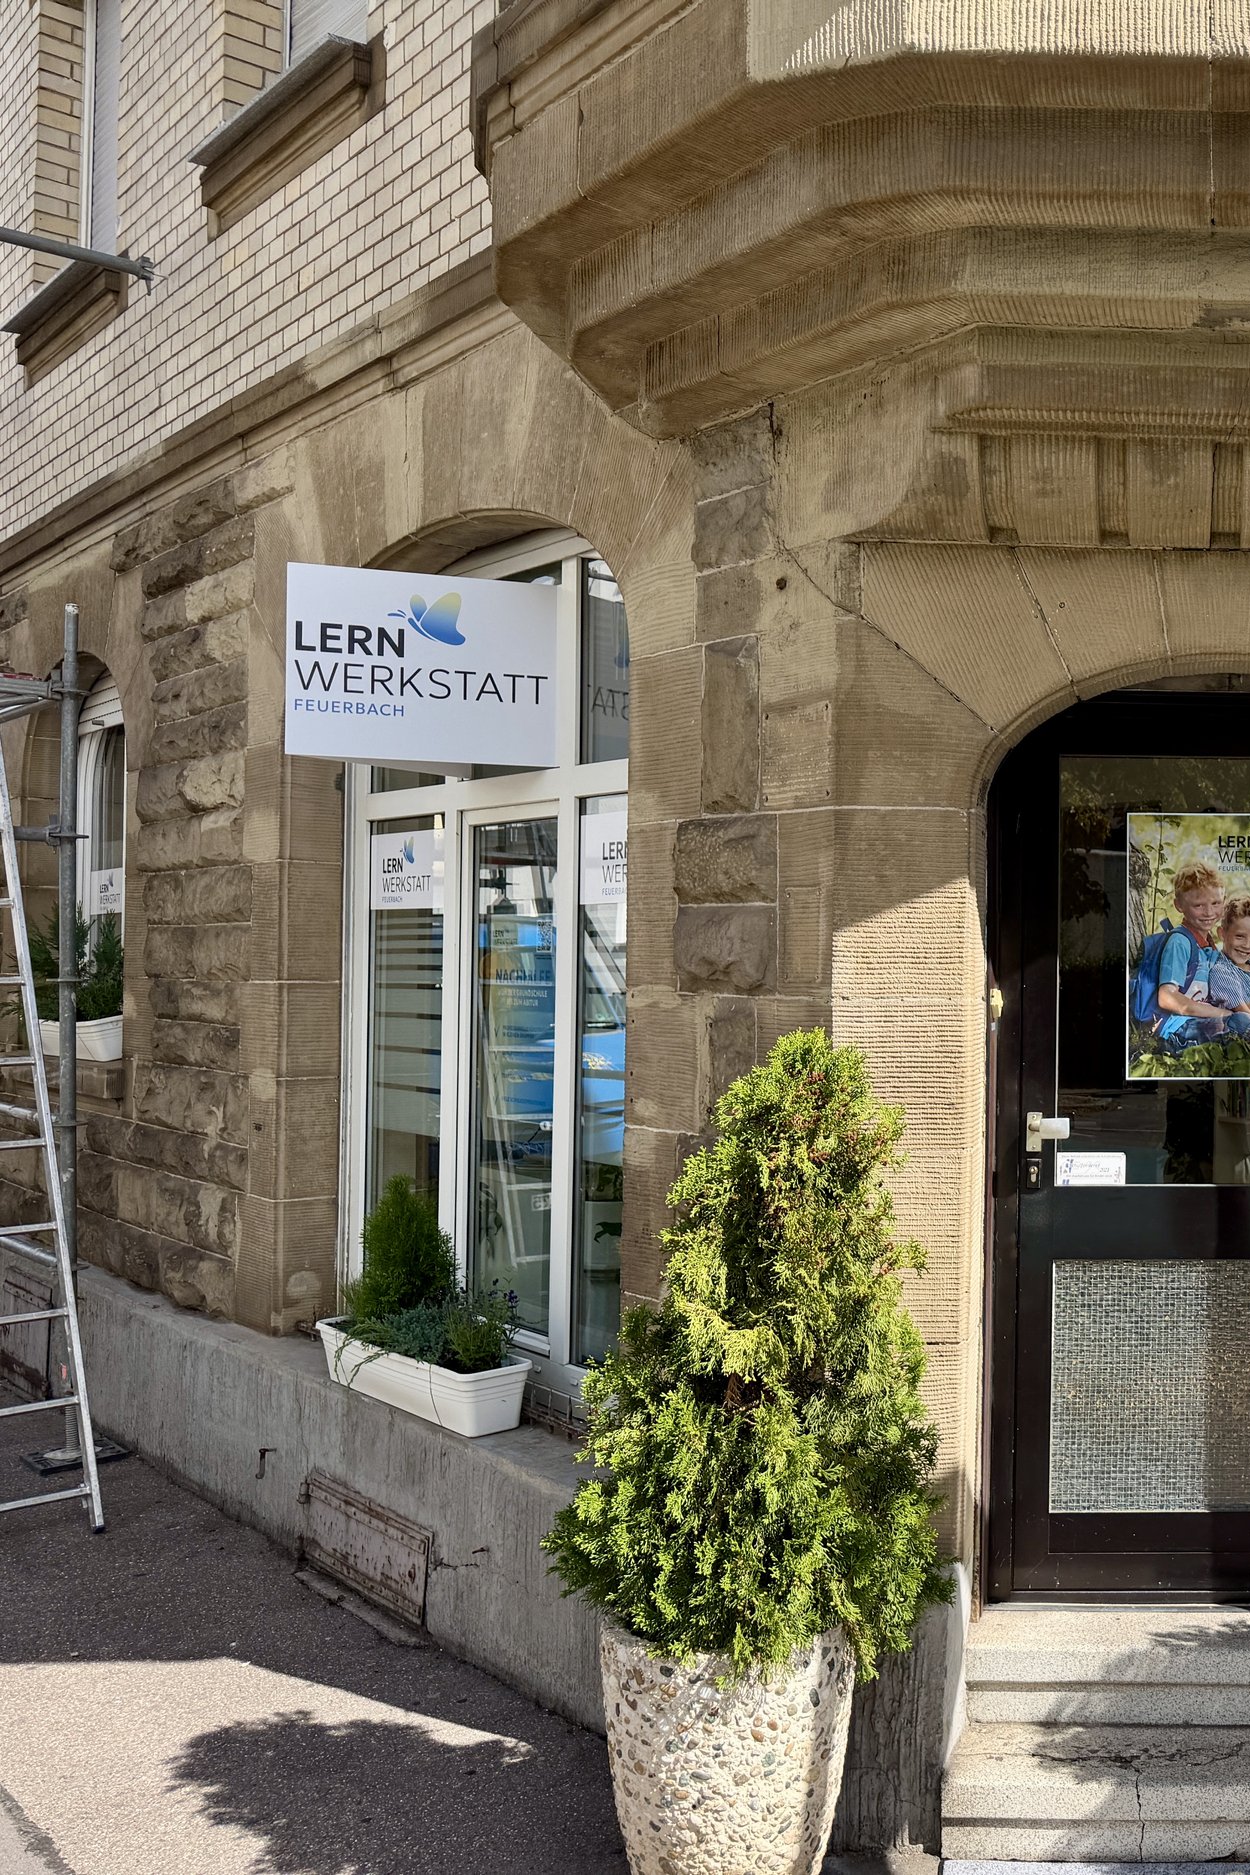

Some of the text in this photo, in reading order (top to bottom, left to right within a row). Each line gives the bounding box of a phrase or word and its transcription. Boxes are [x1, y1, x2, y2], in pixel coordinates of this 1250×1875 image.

[295, 620, 406, 658] LERN
[294, 659, 549, 705] WERKSTATT
[294, 698, 405, 717] FEUERBACH
[382, 858, 404, 873] LERN
[382, 875, 431, 893] WERKSTATT
